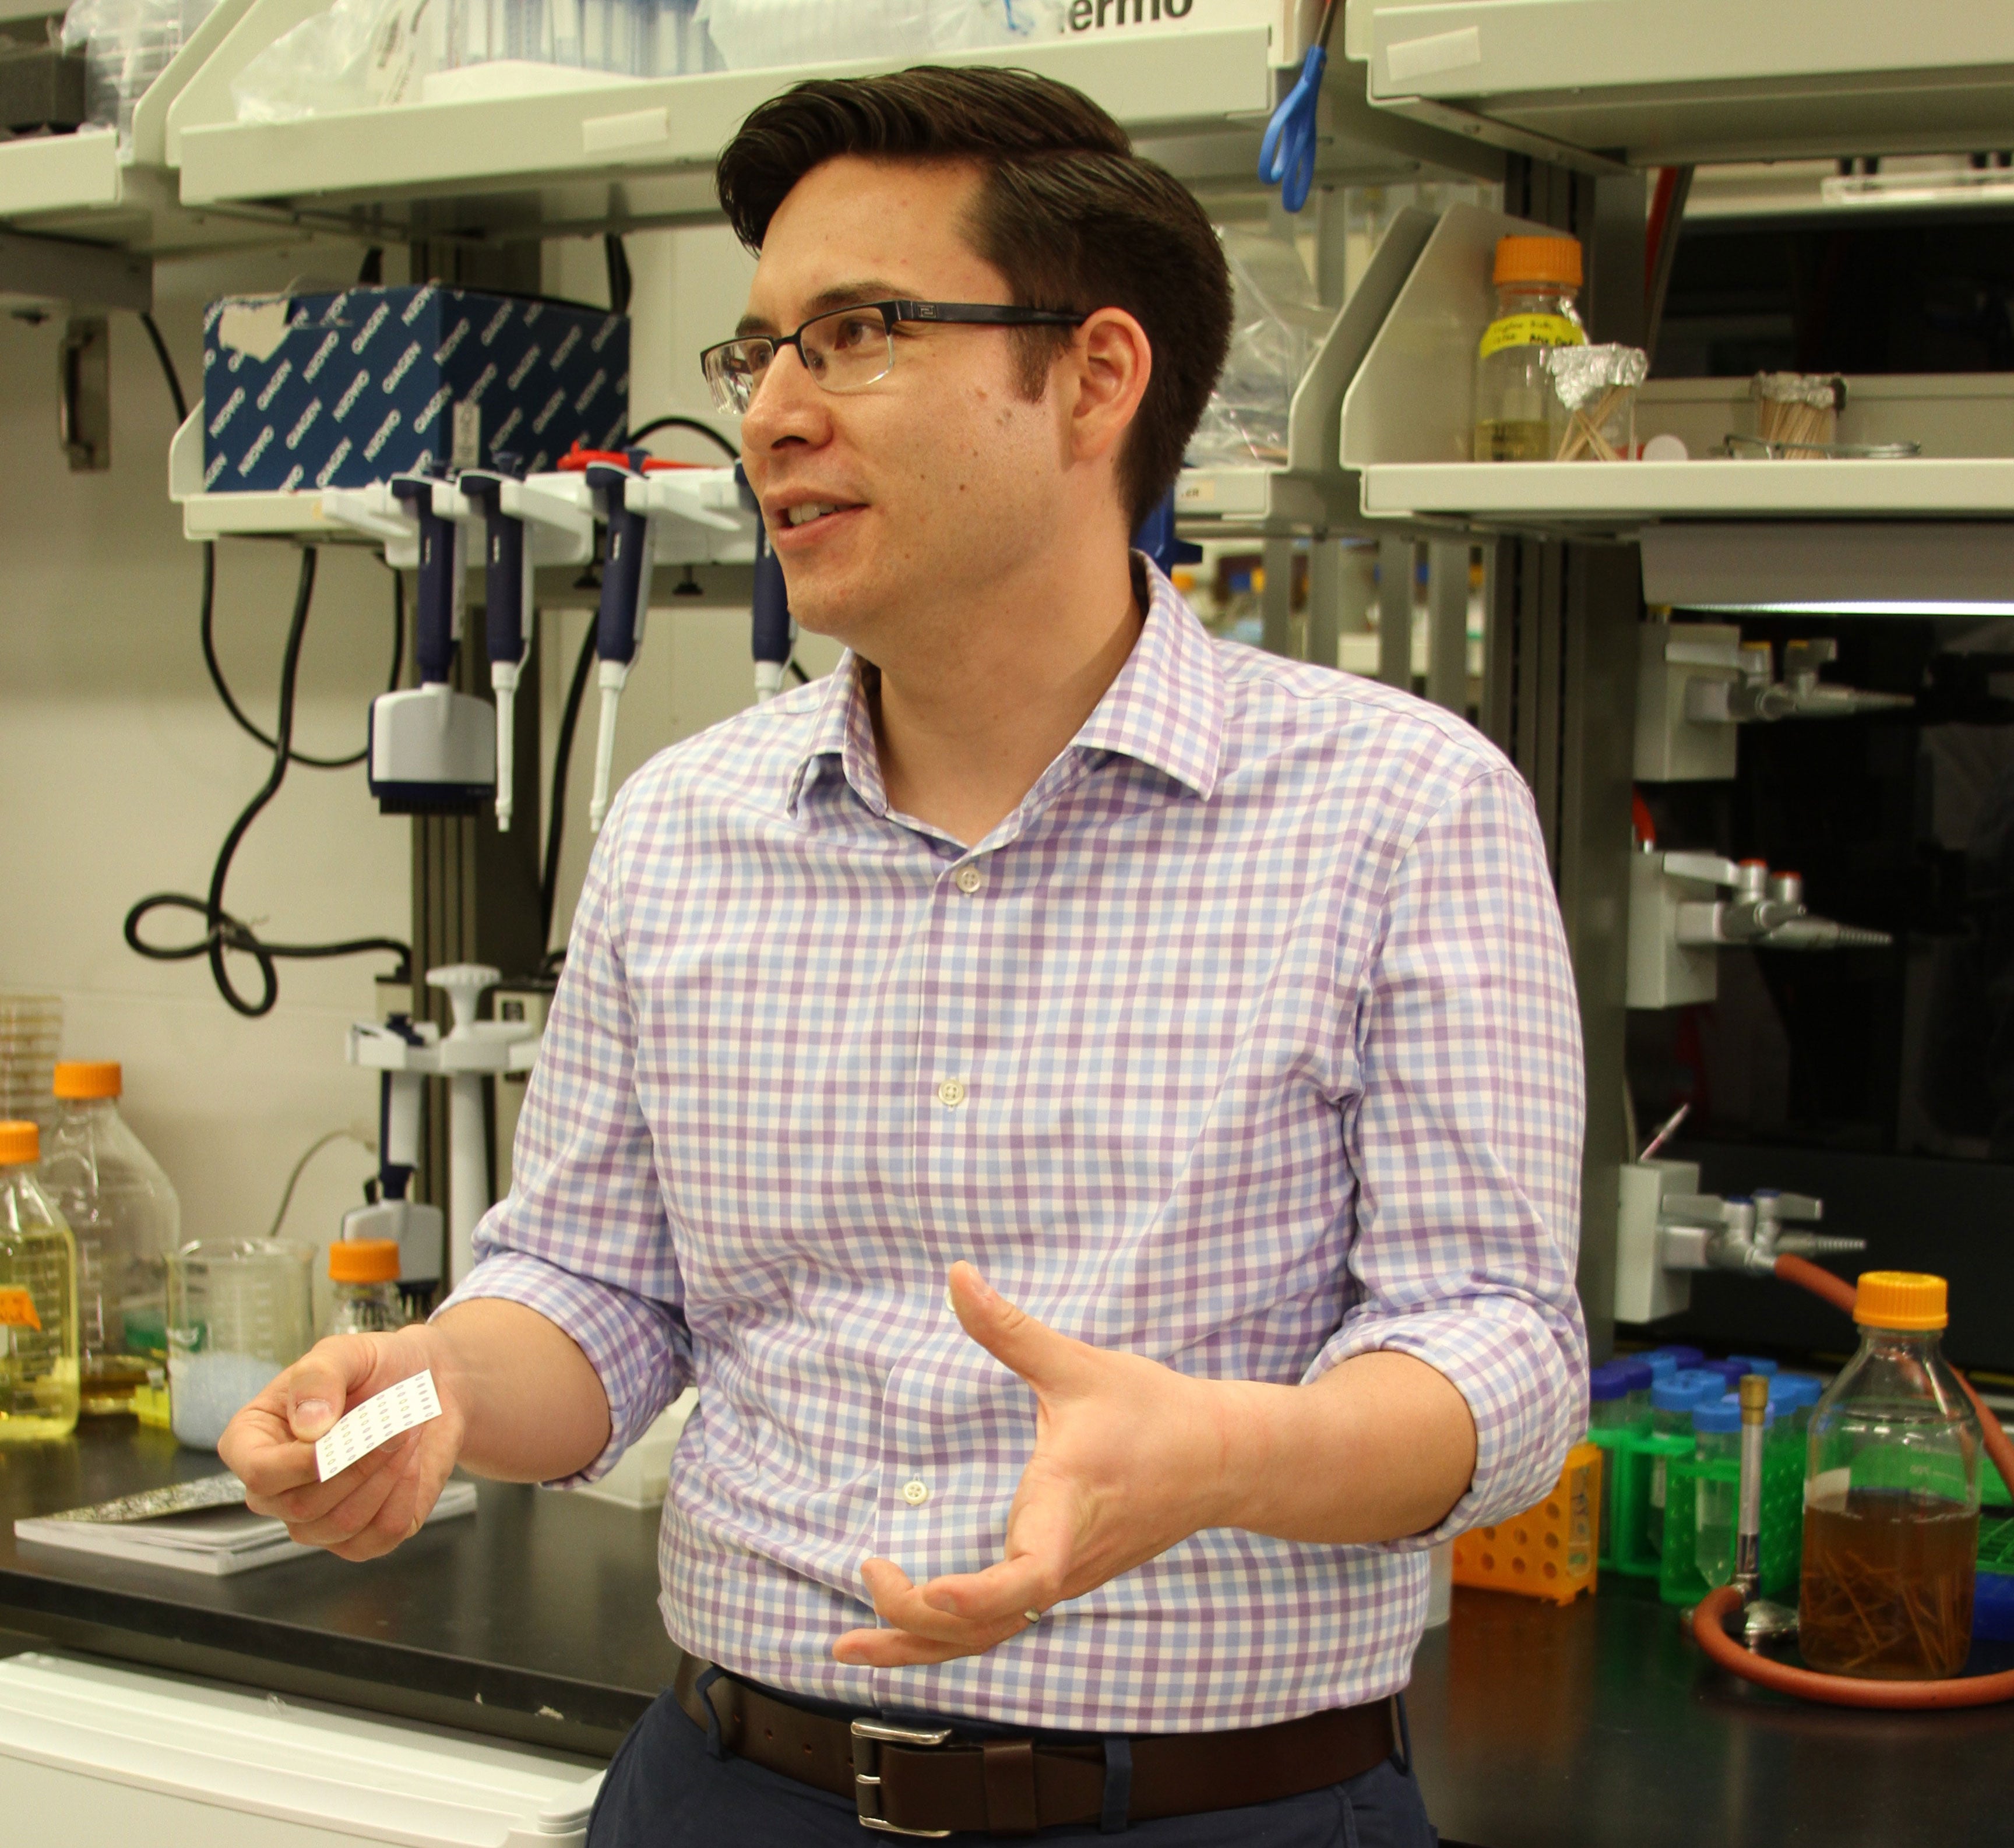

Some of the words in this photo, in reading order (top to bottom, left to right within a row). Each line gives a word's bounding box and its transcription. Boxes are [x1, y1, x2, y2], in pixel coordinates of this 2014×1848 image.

[1061, 0, 1193, 31] ermo
[351, 302, 390, 354] QIAGEN
[302, 330, 340, 383] QIAGEN
[382, 341, 421, 394] QIAGEN
[257, 359, 292, 411] QIAGEN
[332, 369, 370, 423] QIAGEN
[413, 384, 452, 434] QIAGEN
[209, 386, 245, 438] QIAGEN
[286, 397, 322, 450] QIAGEN
[363, 409, 402, 462] QIAGEN
[238, 425, 274, 477] QIAGEN
